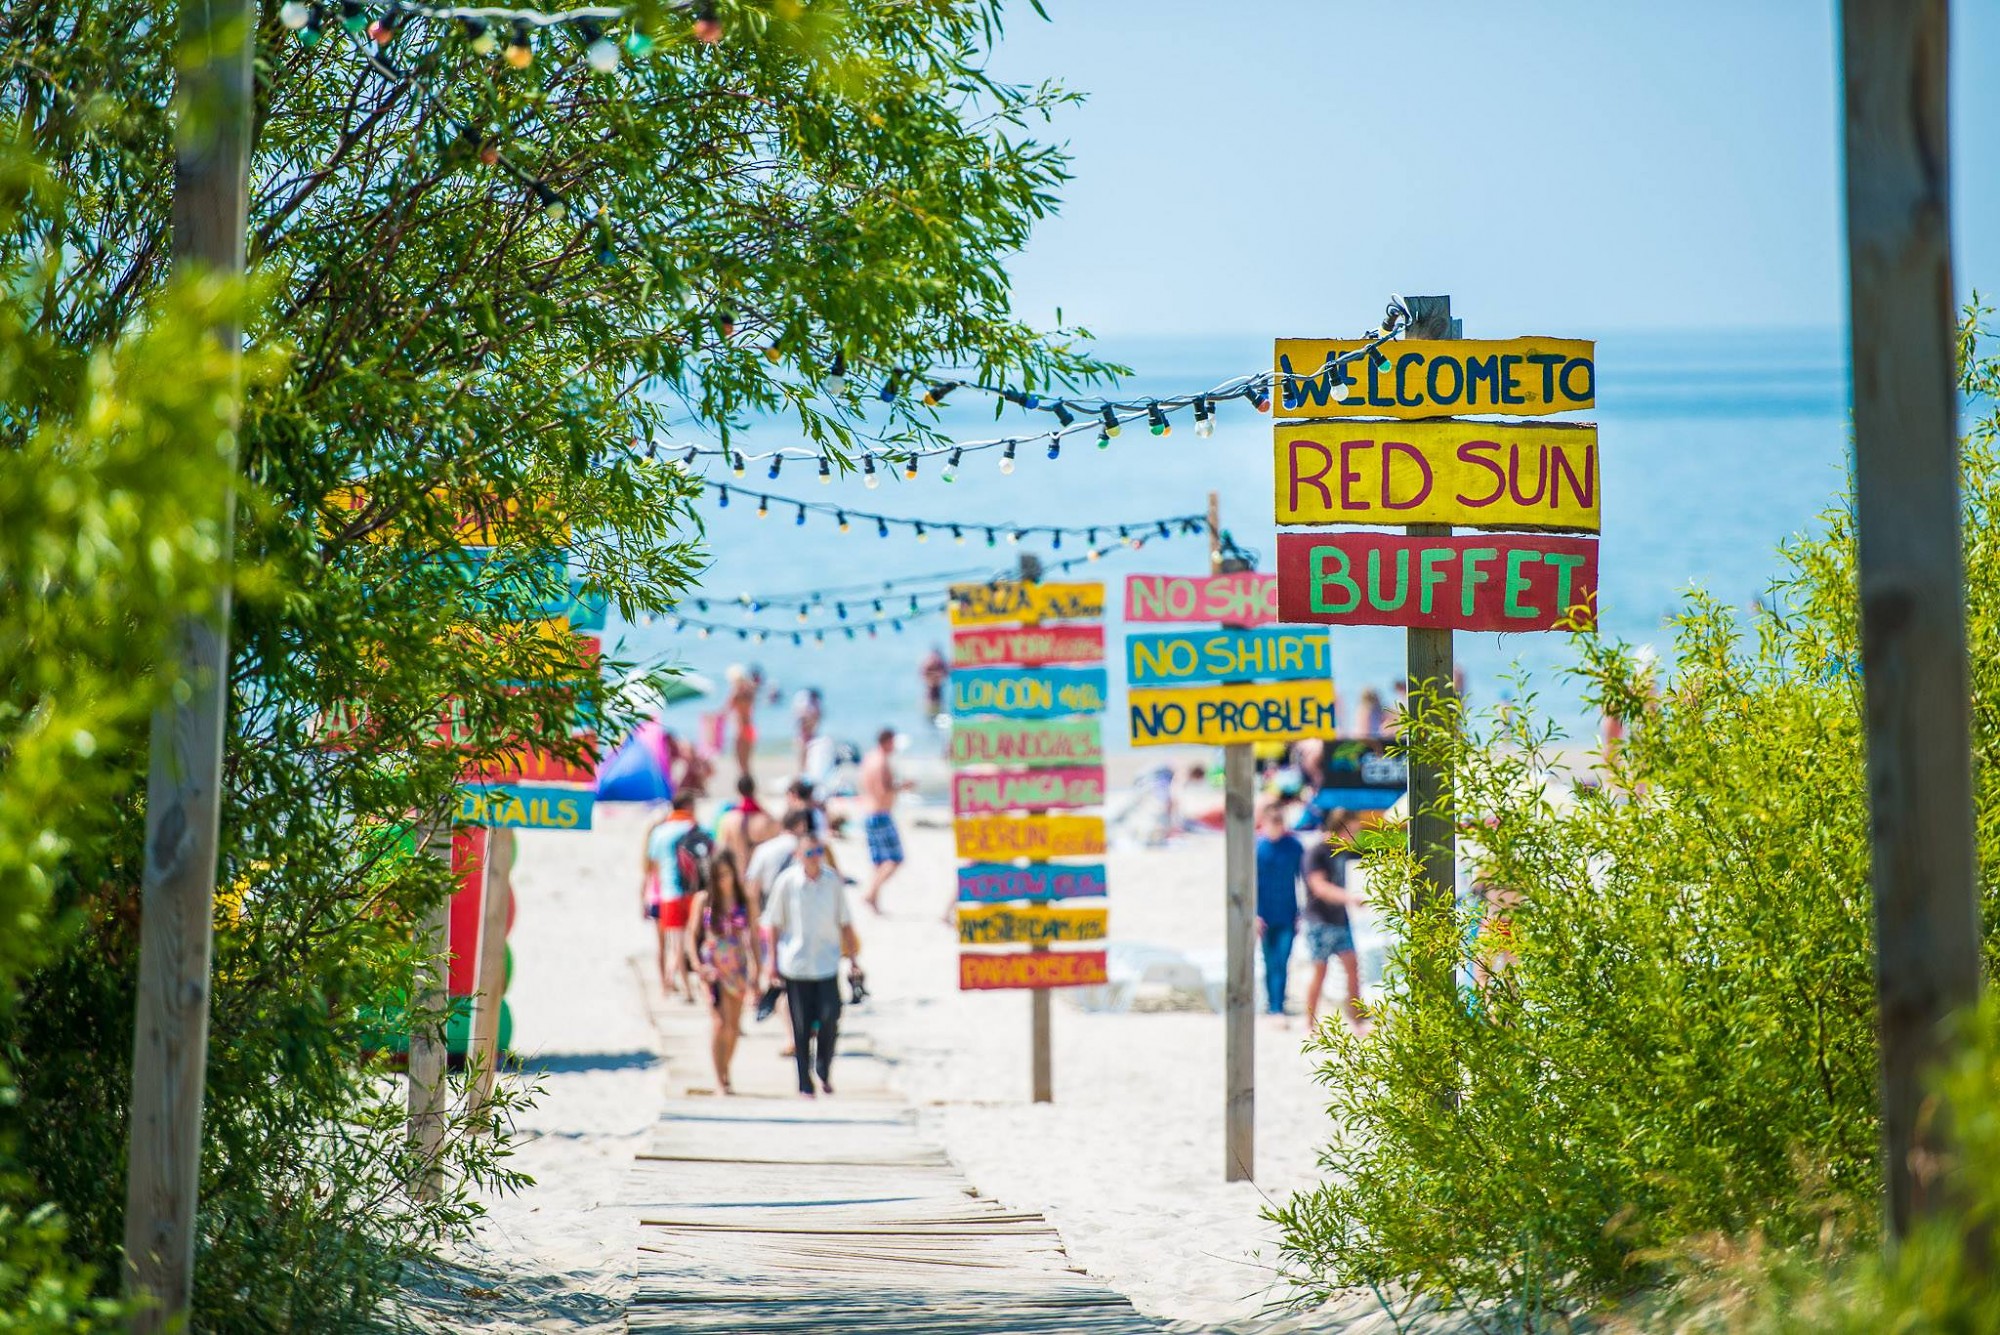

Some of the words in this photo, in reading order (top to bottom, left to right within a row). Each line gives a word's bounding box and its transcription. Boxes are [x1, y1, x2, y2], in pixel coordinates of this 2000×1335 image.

[1289, 440, 1433, 512] RED
[1456, 440, 1594, 509] SUN
[1132, 577, 1197, 617] NO
[1310, 546, 1586, 618] BUFFET
[1134, 639, 1198, 678] NO
[1204, 635, 1329, 674] SHIRT
[956, 678, 1053, 710] LONDON
[1131, 702, 1186, 738] NO
[1197, 696, 1335, 735] PROBLEM
[957, 821, 1049, 855] BERLIN
